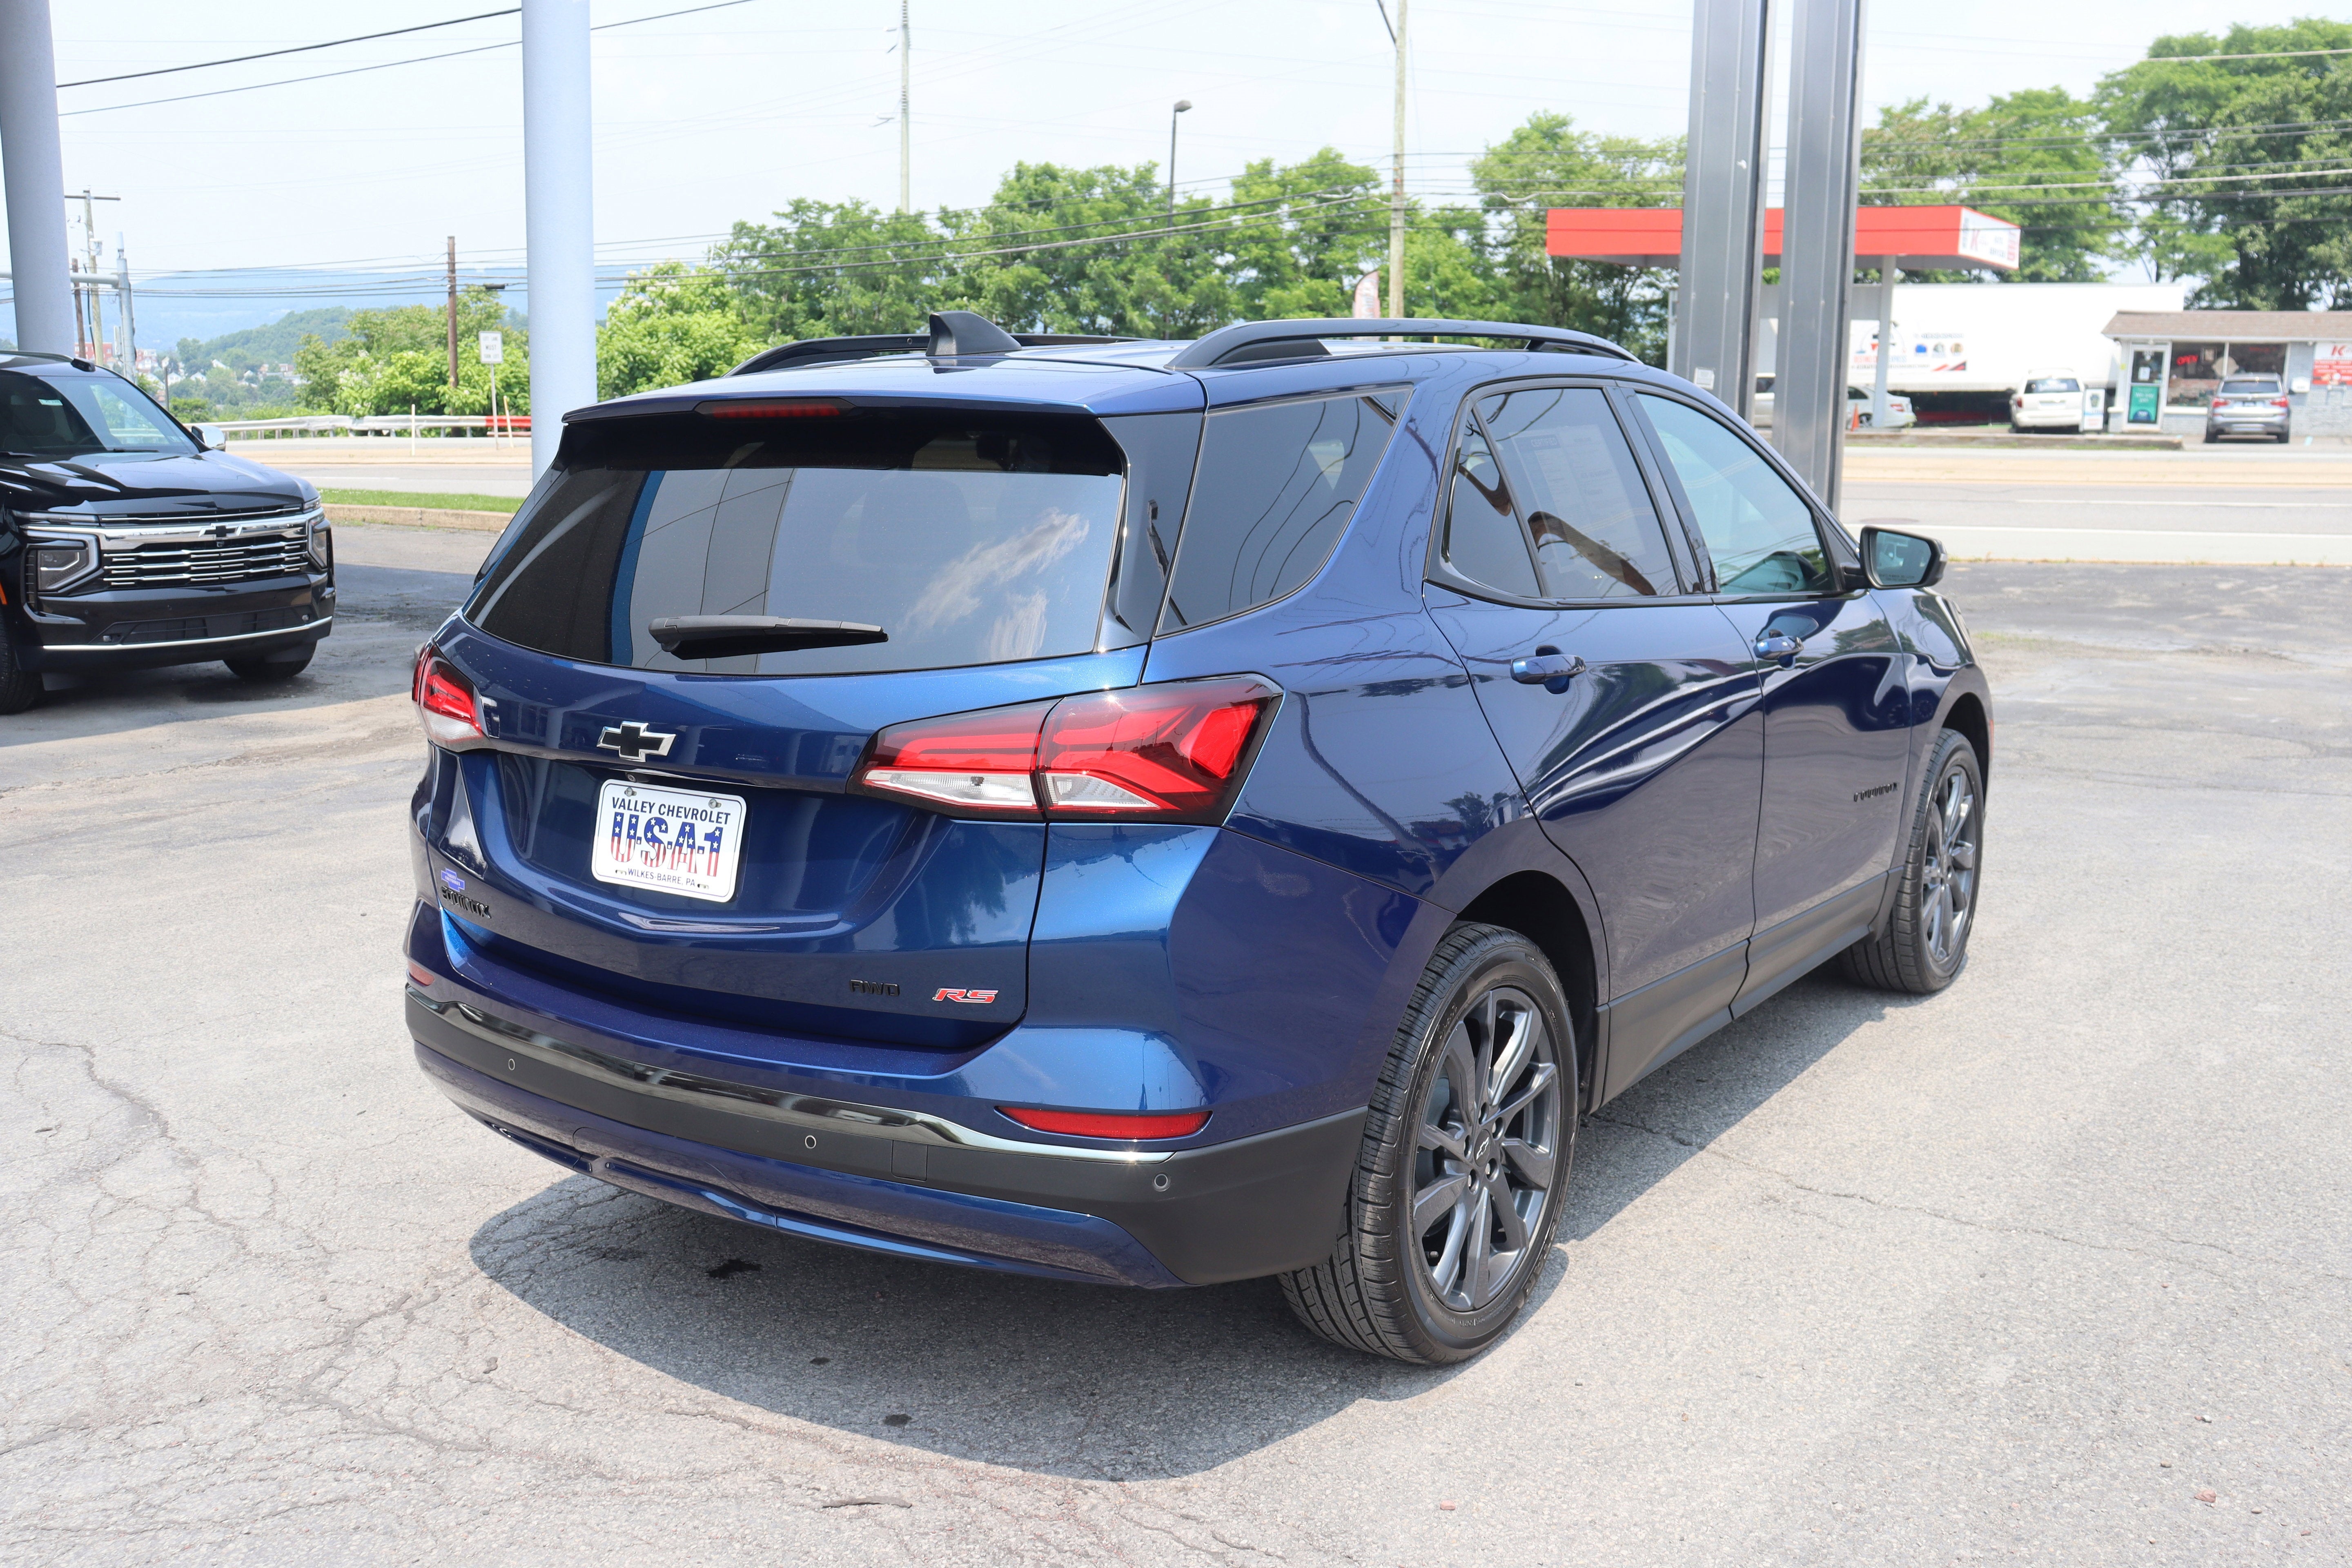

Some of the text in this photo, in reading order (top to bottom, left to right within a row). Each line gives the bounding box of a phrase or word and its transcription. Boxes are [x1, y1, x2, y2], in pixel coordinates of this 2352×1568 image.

[2176, 354, 2198, 366] OPEN
[612, 797, 731, 825] VALLEY CHEVROLET
[628, 868, 695, 887] WILKES-BARRE, PA
[849, 979, 1000, 1004] AWD RS
